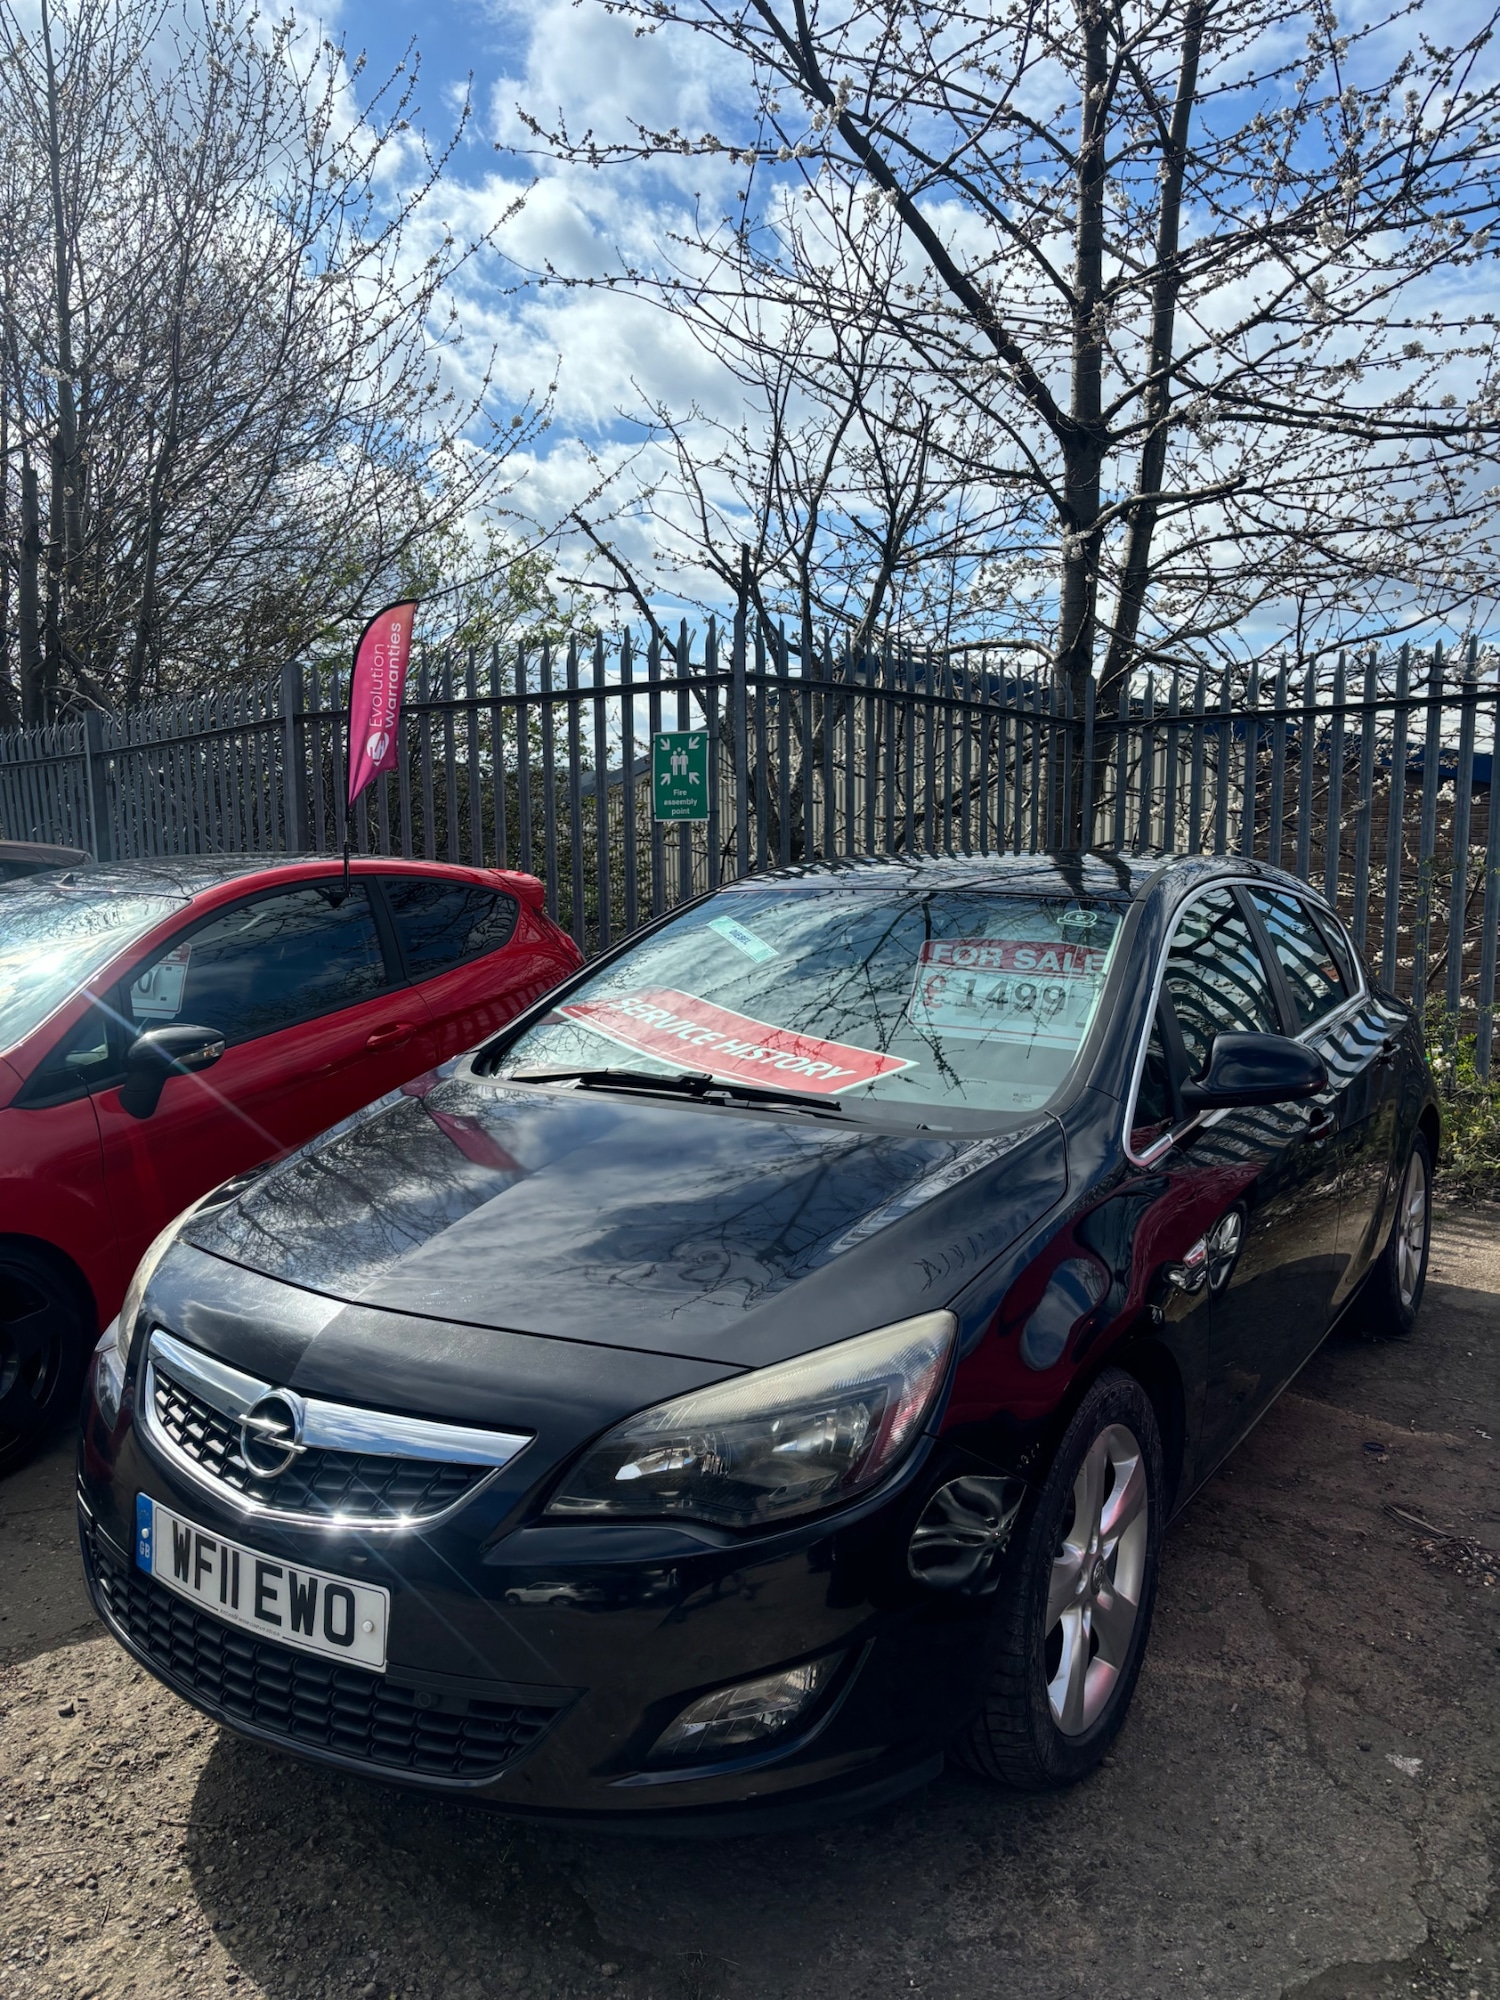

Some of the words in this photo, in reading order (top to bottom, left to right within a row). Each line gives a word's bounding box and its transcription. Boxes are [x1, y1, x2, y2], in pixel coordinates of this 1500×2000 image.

[369, 643, 385, 728] Evolution
[663, 798, 698, 807] assembly
[673, 788, 687, 796] Fire
[671, 808, 690, 816] point
[930, 944, 1004, 968] FOR
[1013, 948, 1106, 975] SALE
[608, 997, 727, 1046] SERVICE
[710, 1039, 858, 1080] HISTORY
[139, 1540, 151, 1559] GB
[254, 1559, 356, 1648] EWO
